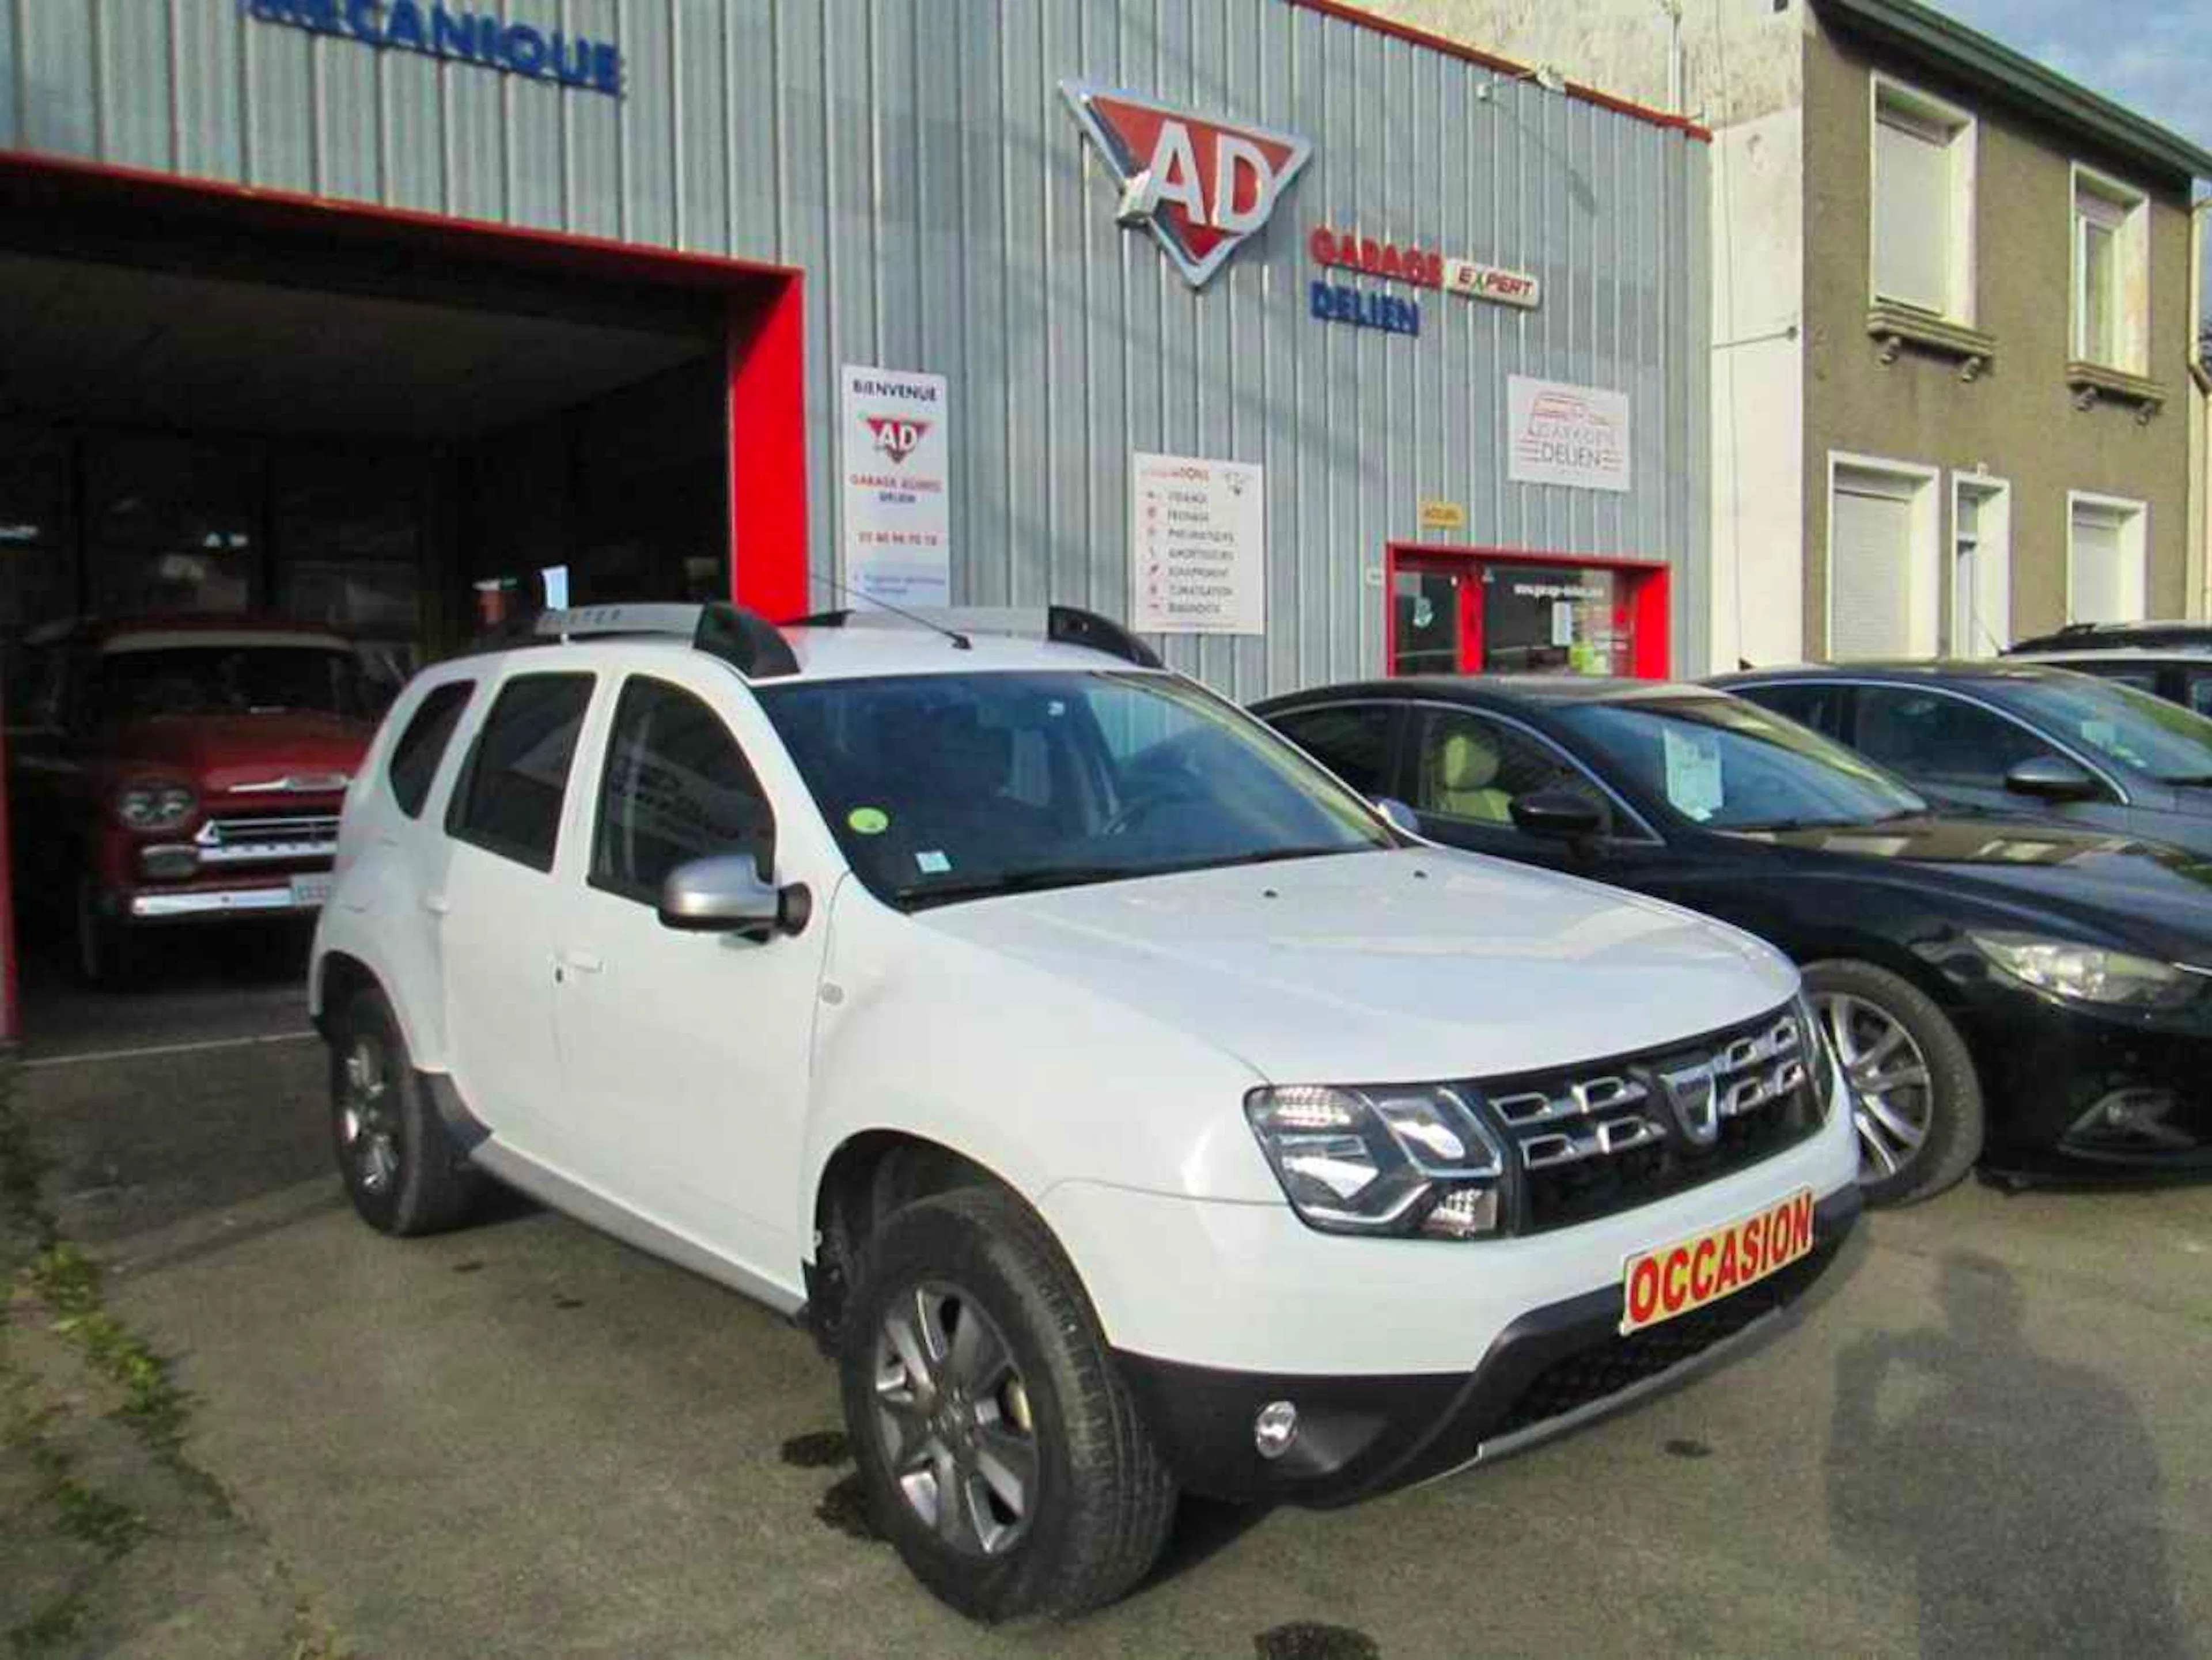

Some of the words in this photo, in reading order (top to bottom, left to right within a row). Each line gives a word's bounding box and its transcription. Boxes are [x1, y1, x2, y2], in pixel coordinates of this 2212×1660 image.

[1146, 118, 1271, 232] AD
[1309, 225, 1443, 290] GARAGE
[1458, 268, 1533, 297] EXPERT
[1310, 281, 1419, 335] DELIEN
[853, 378, 938, 402] BIENVENUE
[878, 422, 918, 452] AD
[1629, 1192, 1812, 1323] OCCASION
